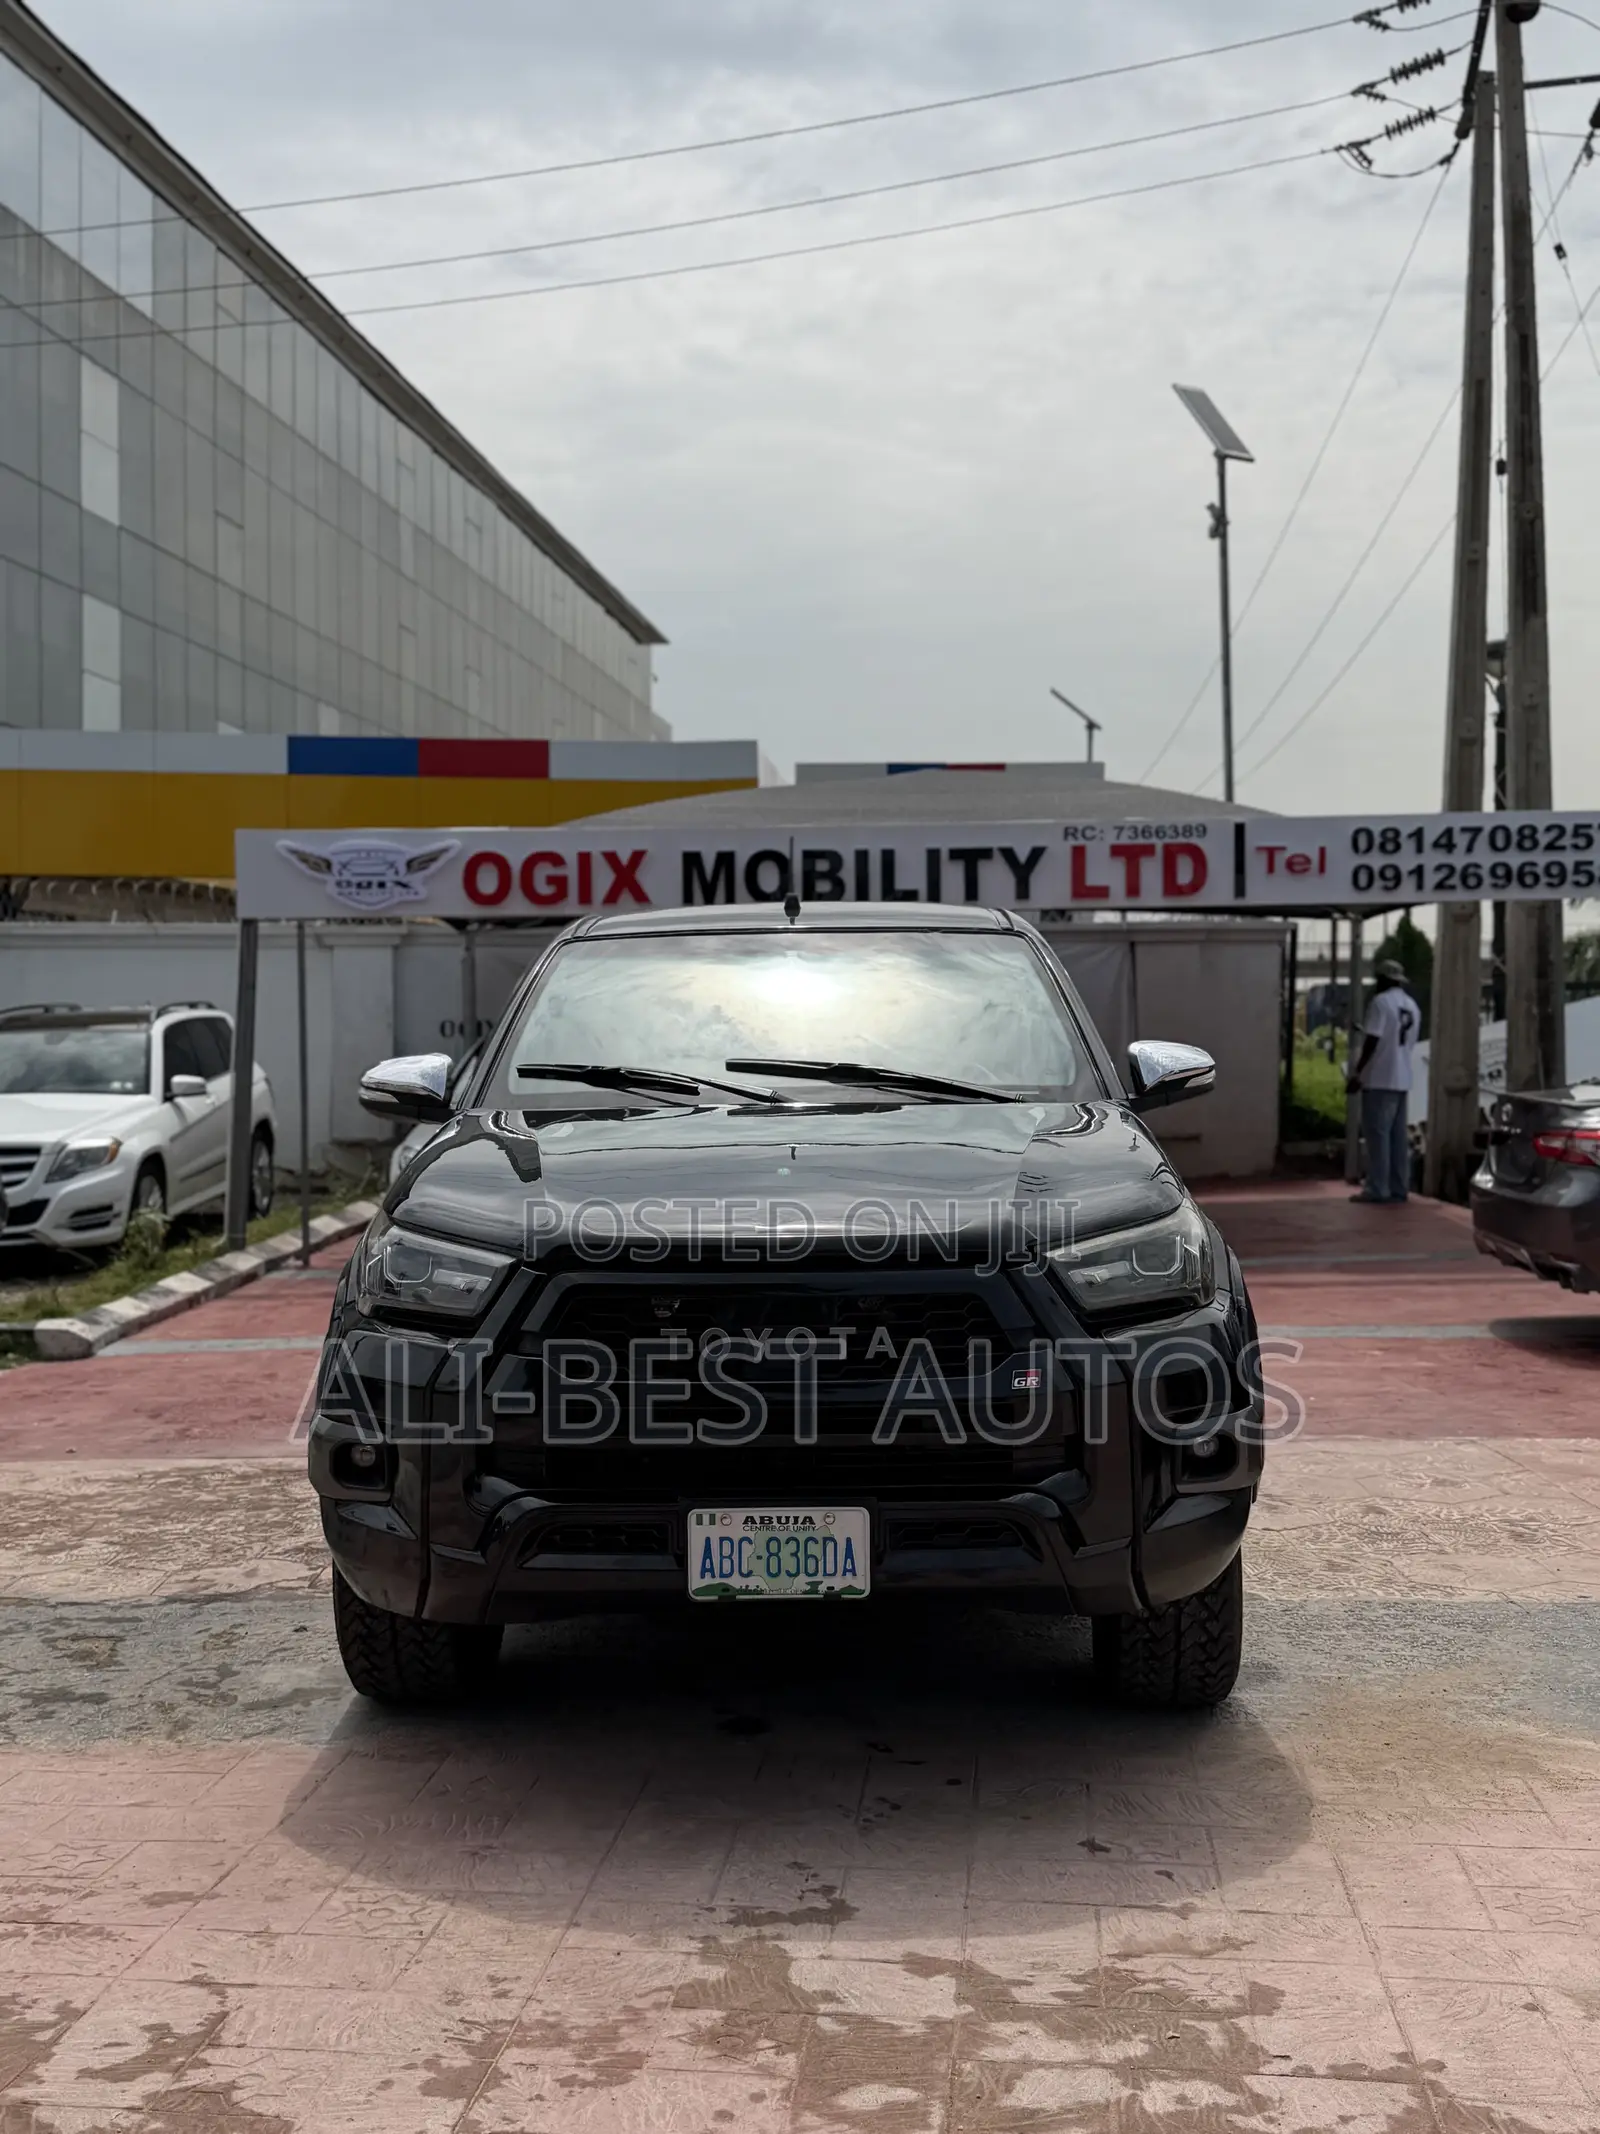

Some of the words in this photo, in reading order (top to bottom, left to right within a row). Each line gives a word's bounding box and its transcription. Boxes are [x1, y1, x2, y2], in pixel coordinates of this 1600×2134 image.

[1063, 825, 1104, 842] RC:
[1114, 823, 1208, 842] 7366389
[1351, 823, 1600, 855] 081470825
[461, 849, 650, 906] OGIX
[681, 846, 1049, 906] MOBILITY
[1069, 842, 1209, 900] LTD
[1256, 845, 1327, 877] Tel
[1351, 860, 1600, 892] 091269695
[660, 1326, 898, 1362] TOYOTA
[1013, 1376, 1039, 1387] GR
[742, 1515, 816, 1525] ABUJA
[700, 1536, 858, 1579] ABC-836DA
